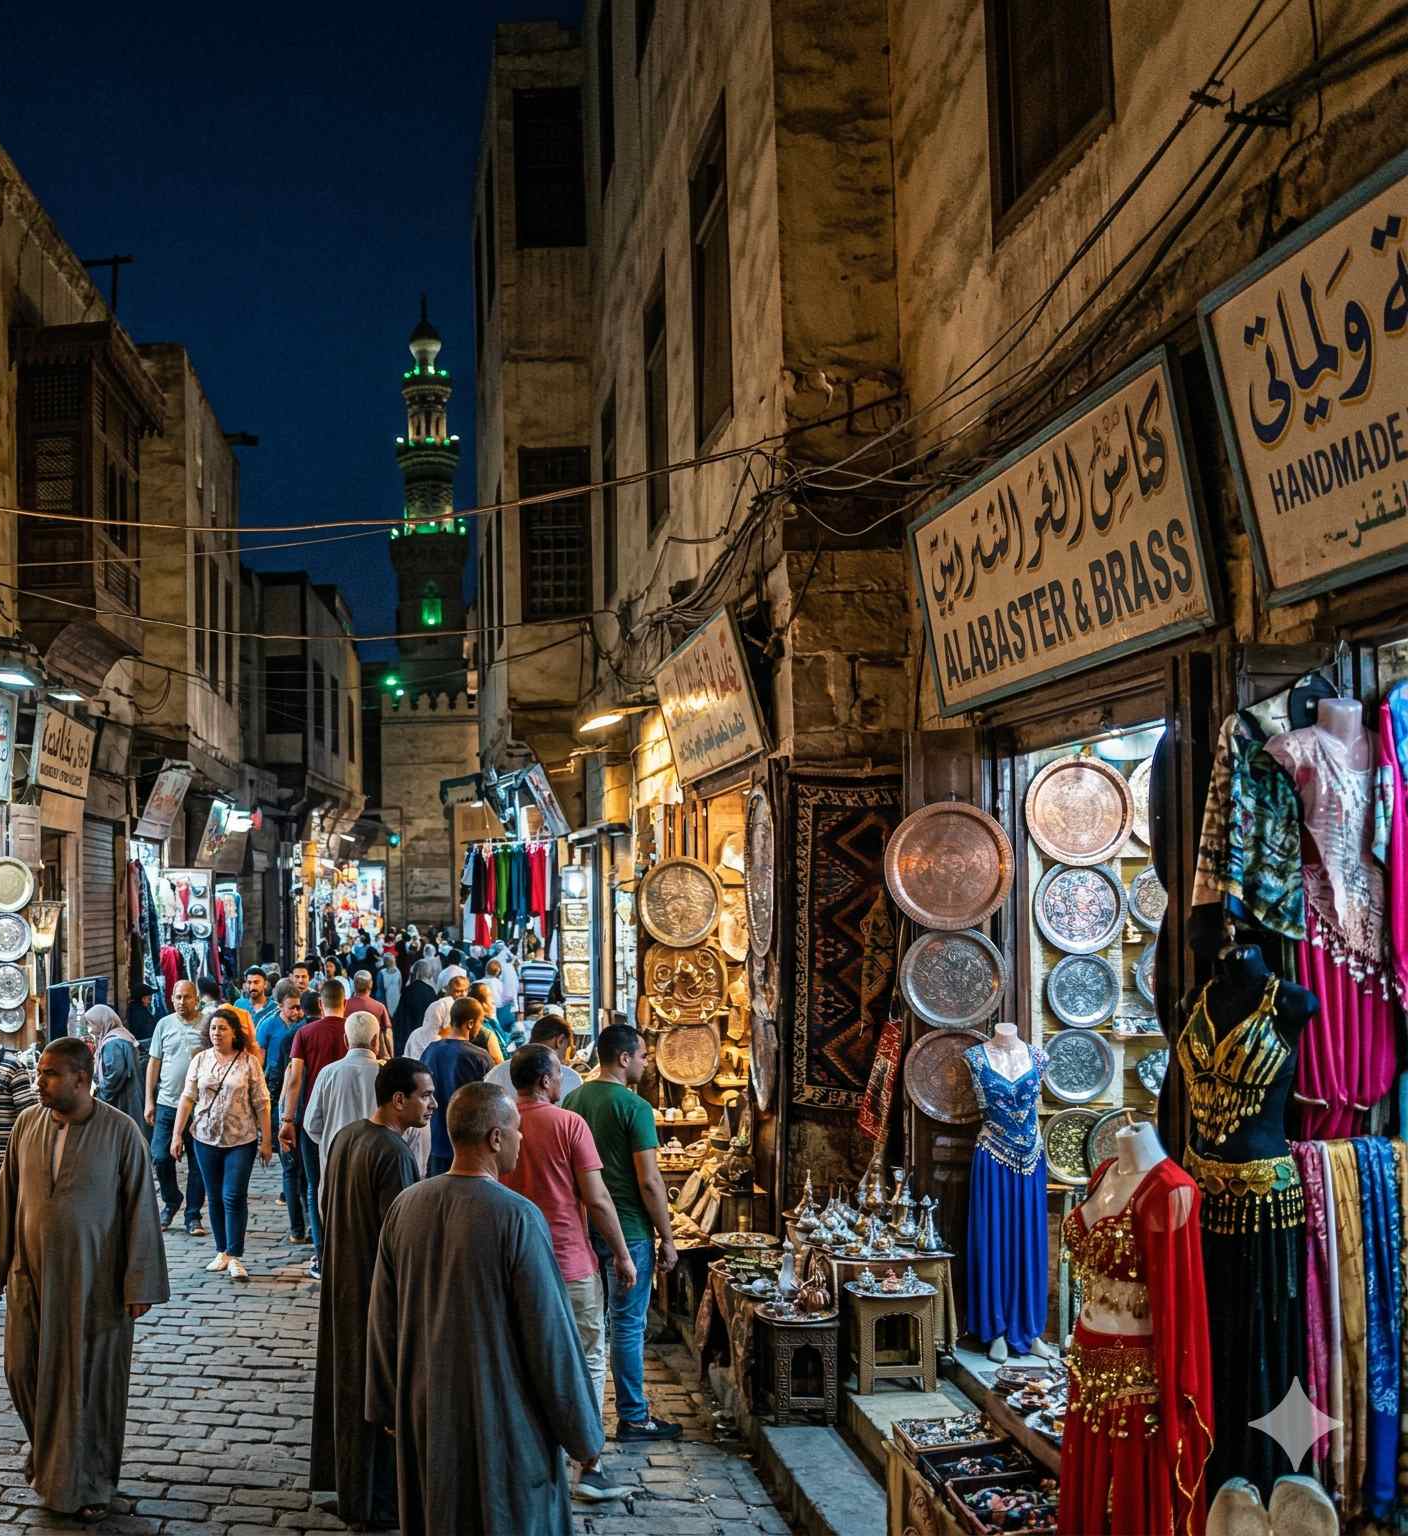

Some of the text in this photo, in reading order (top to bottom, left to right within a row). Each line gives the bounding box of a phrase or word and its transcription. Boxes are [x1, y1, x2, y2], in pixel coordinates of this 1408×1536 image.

[1268, 411, 1408, 515] HANDMADE
[943, 579, 1074, 687] ALABASTER
[1072, 578, 1091, 633] &
[1089, 517, 1194, 627] BRASS
